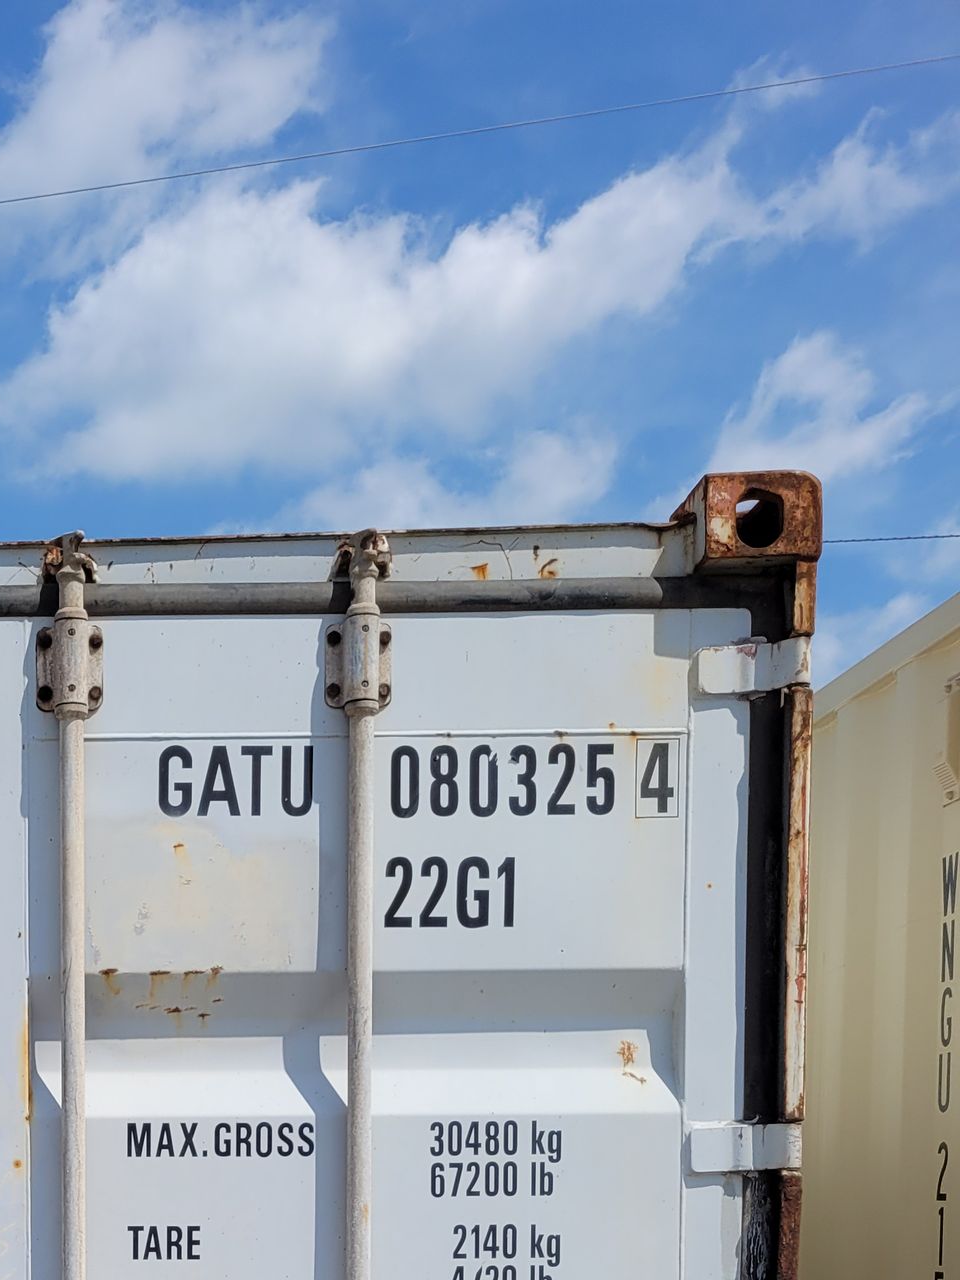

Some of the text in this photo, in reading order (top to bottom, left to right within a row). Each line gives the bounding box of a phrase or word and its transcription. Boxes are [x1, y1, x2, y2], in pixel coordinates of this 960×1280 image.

[158, 742, 674, 818] GATU 080325 4
[384, 856, 516, 929] 22G1
[937, 851, 960, 1114] WNGU
[127, 1120, 562, 1164] MAX.GROSS 30480 kg
[430, 1161, 554, 1198] 67200 lb
[127, 1223, 561, 1268] TARE 2140 kg
